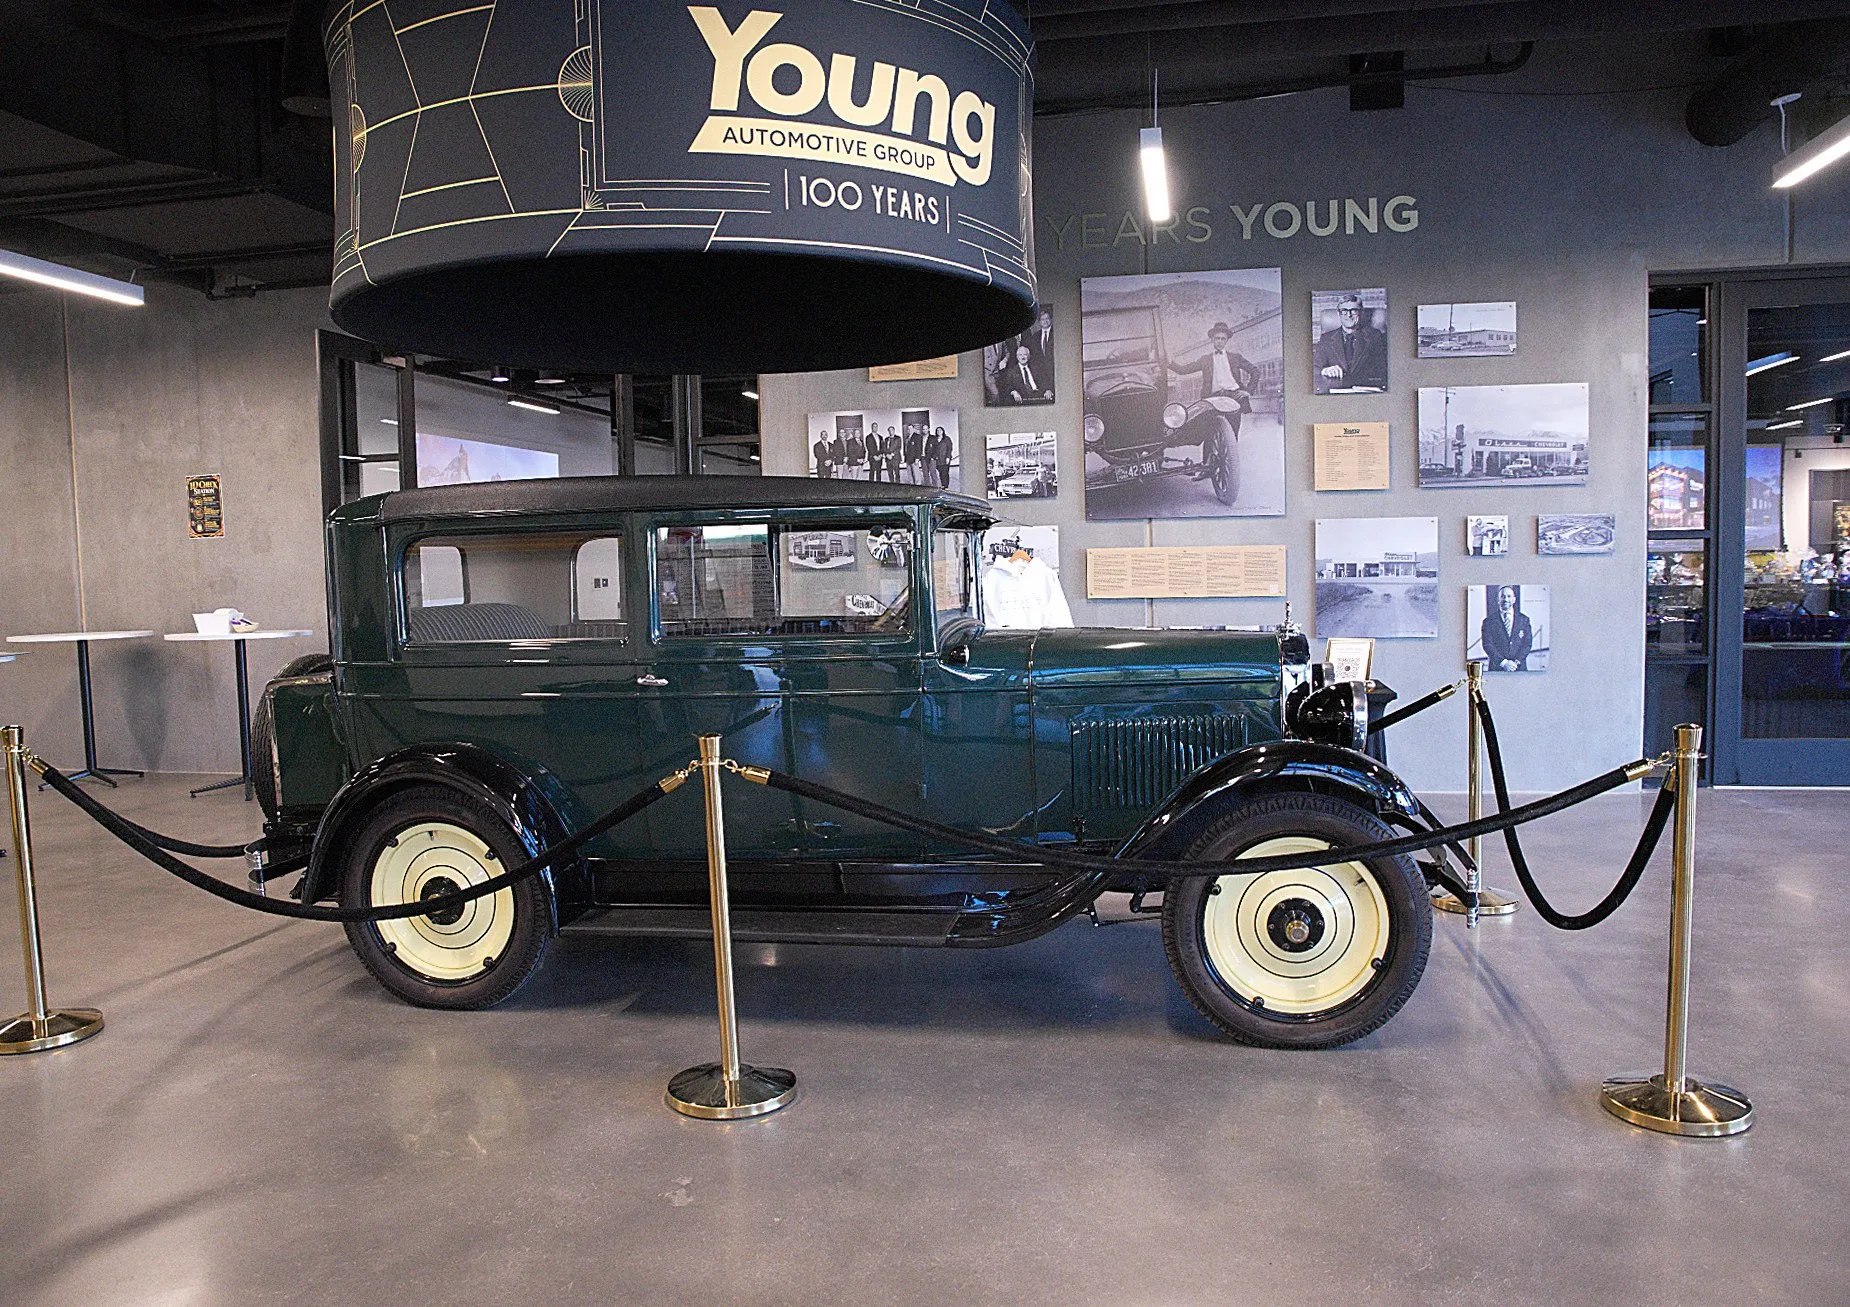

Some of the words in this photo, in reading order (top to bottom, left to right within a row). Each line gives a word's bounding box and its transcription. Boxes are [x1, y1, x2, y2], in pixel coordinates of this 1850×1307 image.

[687, 6, 996, 186] Young
[723, 126, 867, 157] AUTOMOTIVE
[873, 144, 936, 171] GROUP
[800, 175, 862, 210] 100
[871, 185, 939, 225] YEARS
[1045, 206, 1212, 250] YEARS
[1230, 196, 1419, 241] YOUNG
